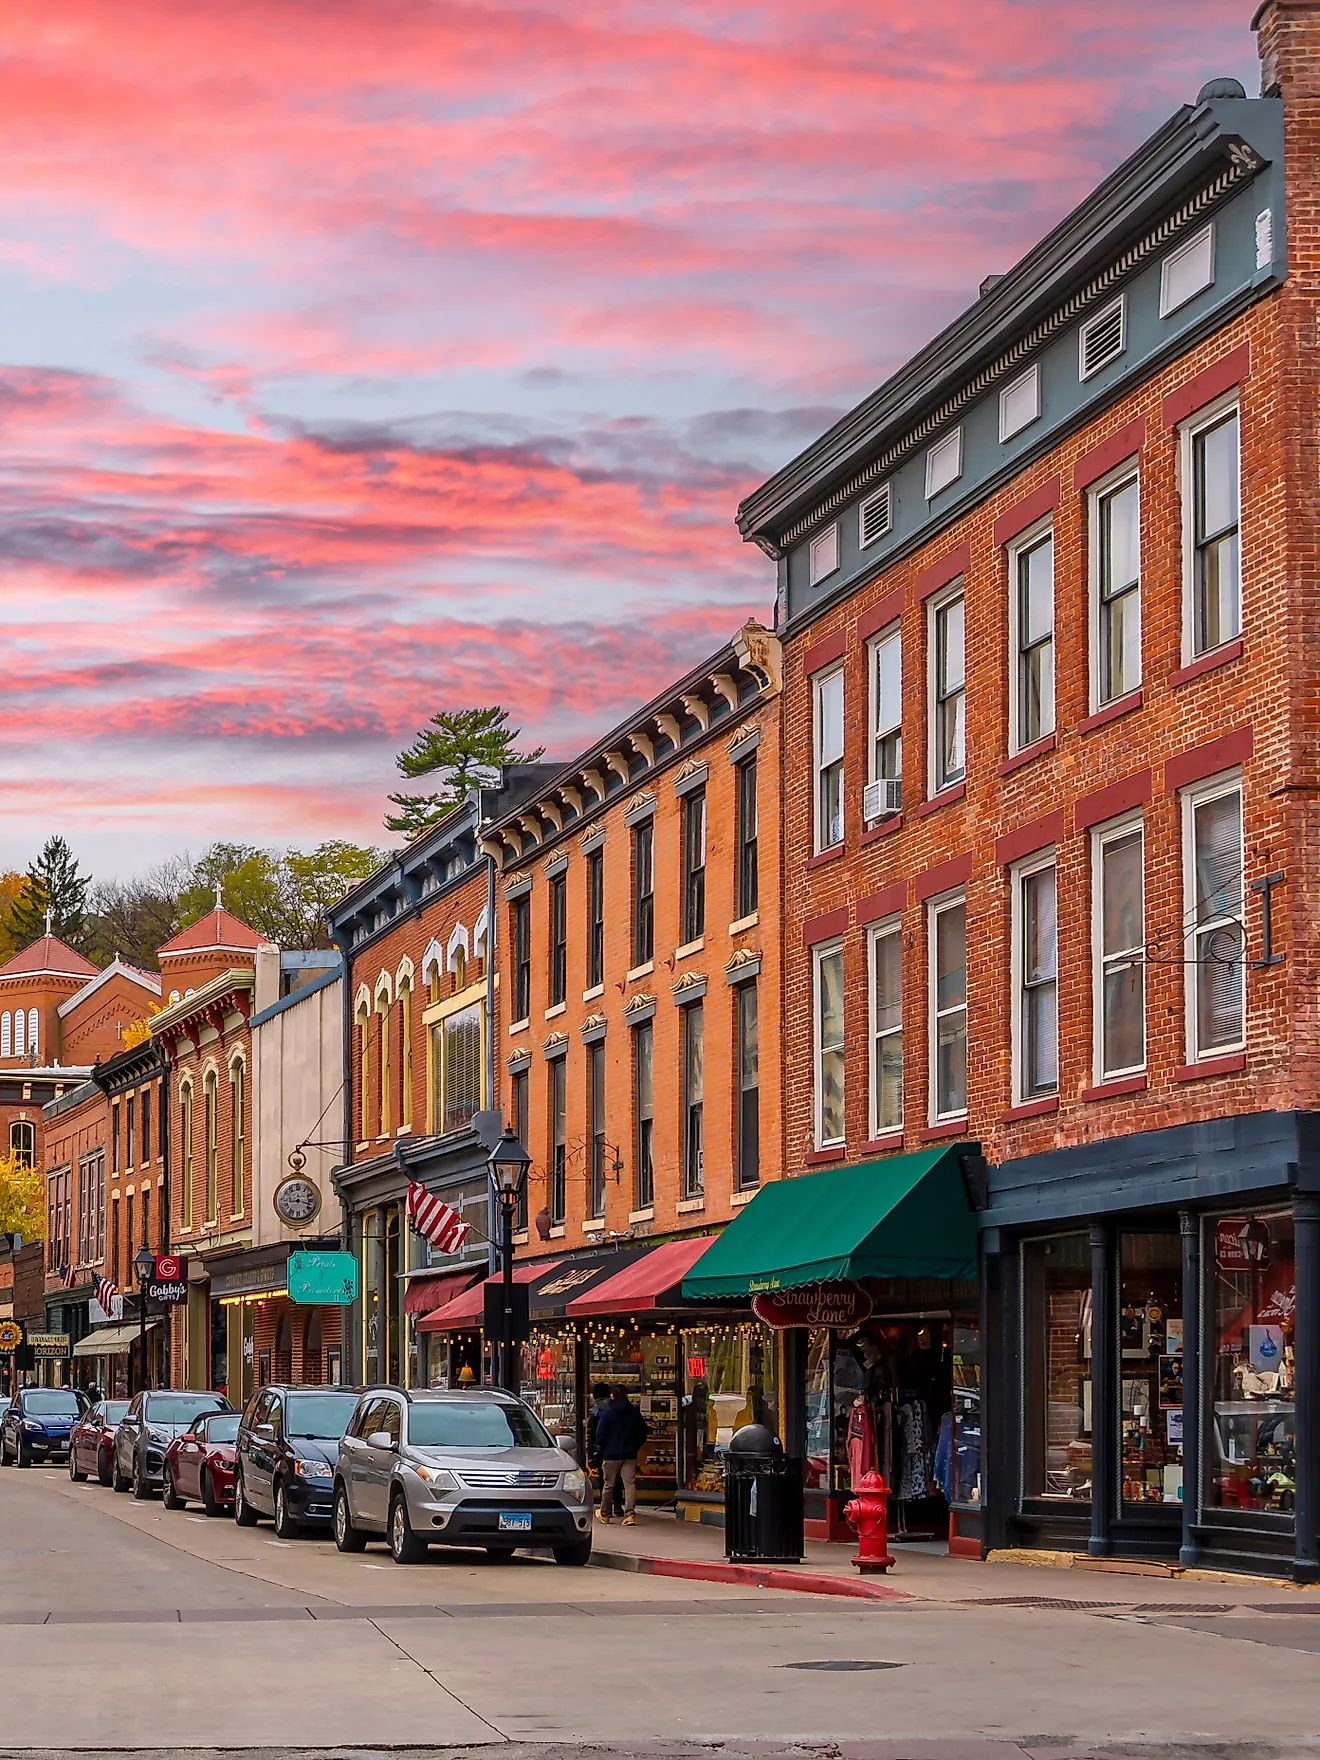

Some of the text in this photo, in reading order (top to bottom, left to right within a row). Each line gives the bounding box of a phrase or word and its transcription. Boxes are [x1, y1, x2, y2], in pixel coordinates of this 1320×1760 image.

[159, 1258, 177, 1277] G
[307, 1255, 337, 1268] Petals
[149, 1283, 188, 1301] Gabby's
[158, 1294, 177, 1302] GIFTS
[772, 1287, 856, 1315] Strawberry
[806, 1302, 848, 1323] Lane
